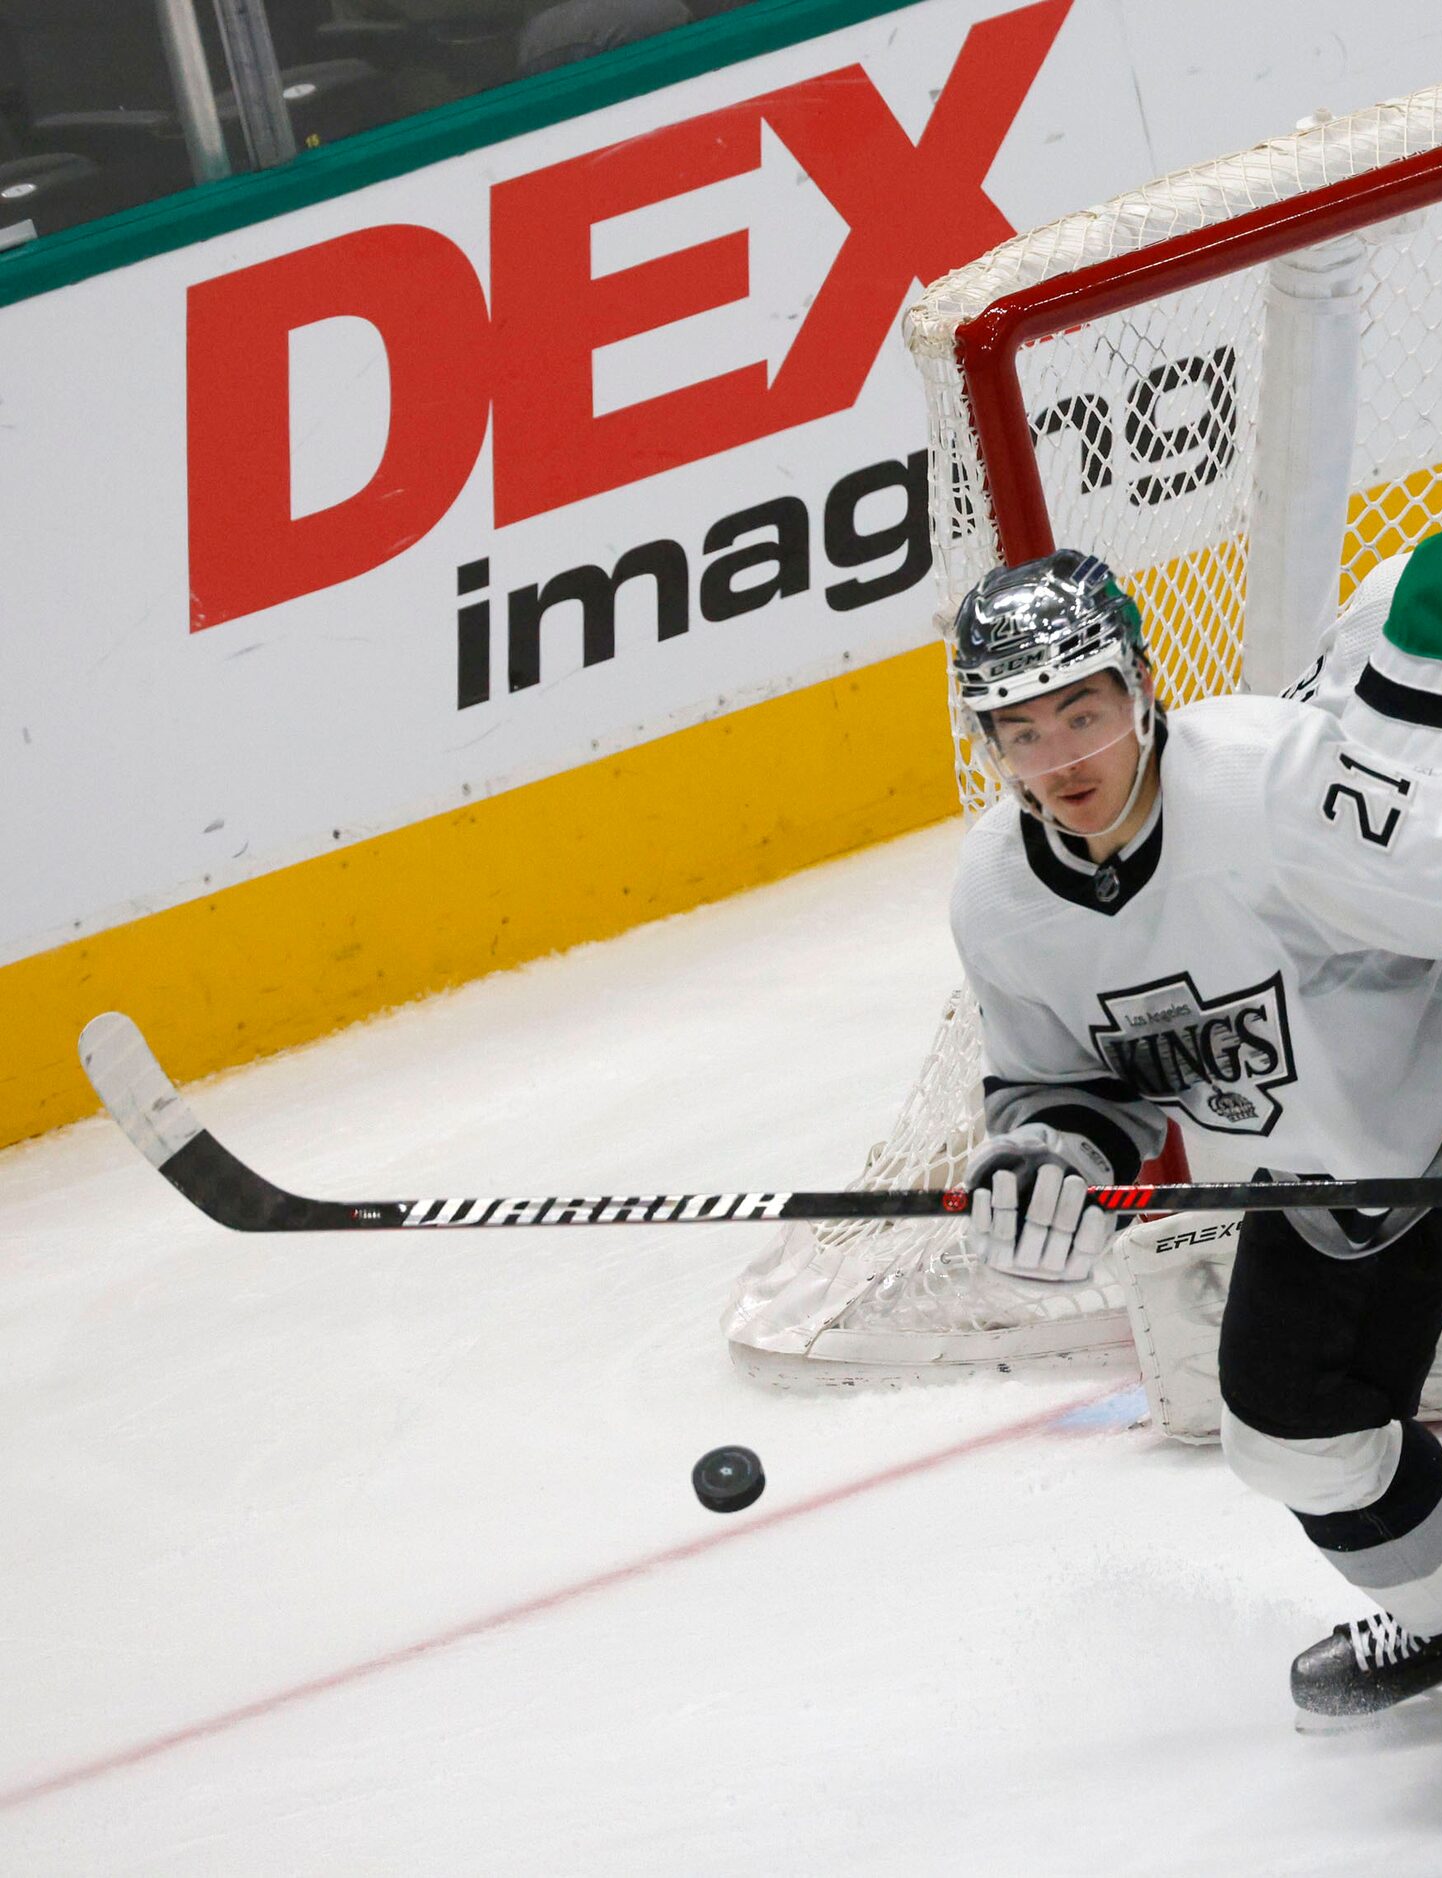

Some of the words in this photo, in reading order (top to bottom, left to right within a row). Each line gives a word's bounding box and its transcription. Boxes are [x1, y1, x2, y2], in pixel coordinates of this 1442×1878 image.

[187, 0, 1075, 633] DEX
[990, 651, 1041, 677] CCM
[1322, 752, 1411, 848] 21
[1125, 1014, 1147, 1028] Los
[1147, 1003, 1191, 1024] Angeles
[1110, 1004, 1278, 1096] KINGS
[401, 1194, 793, 1228] WARRIOR
